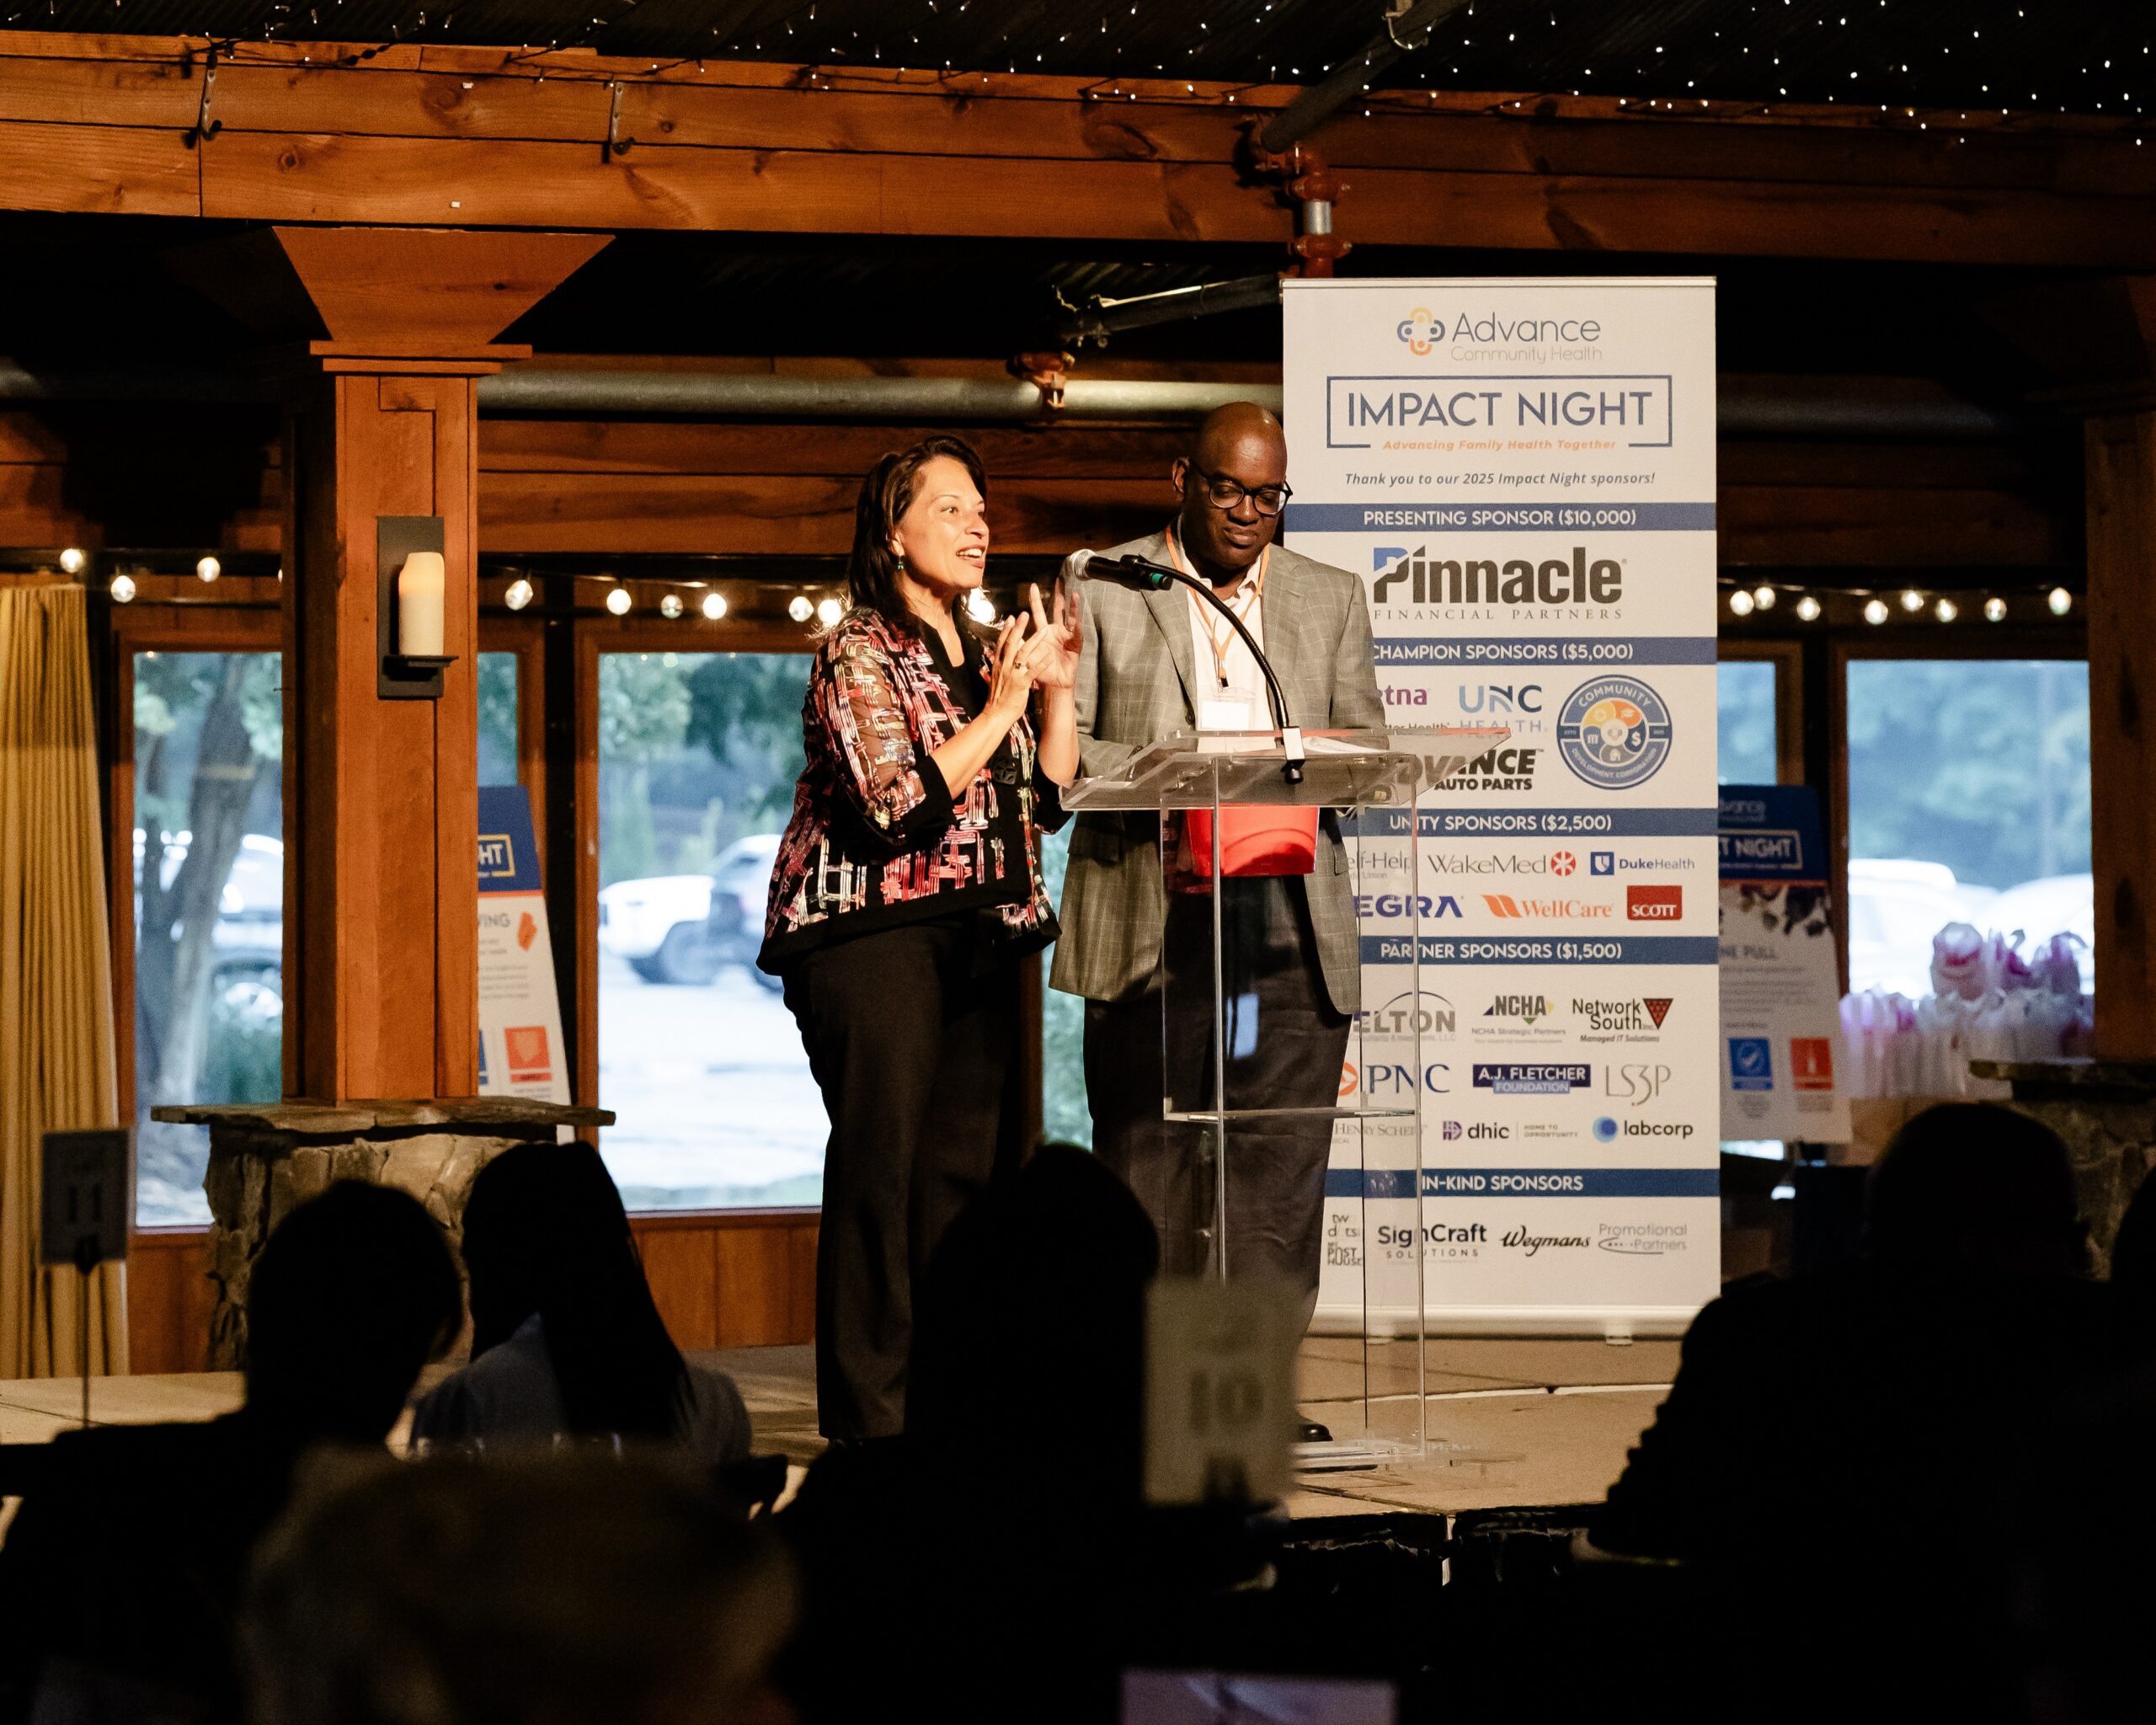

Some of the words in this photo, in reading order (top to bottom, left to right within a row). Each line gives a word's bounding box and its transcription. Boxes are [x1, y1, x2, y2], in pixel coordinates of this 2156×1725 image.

[1451, 312, 1601, 344] Advance
[1450, 345, 1546, 365] Community
[1551, 345, 1603, 361] Health
[1348, 392, 1502, 426] IMPACT
[1518, 391, 1652, 426] NIGHT
[1382, 440, 1454, 452] Advancing
[1459, 440, 1503, 451] Family
[1508, 440, 1553, 451] Health
[1557, 440, 1616, 451] Together
[1345, 473, 1386, 485] Thank
[1390, 476, 1414, 488] you
[1418, 474, 1433, 485] to
[1436, 476, 1459, 485] our
[1463, 473, 1494, 485] 2025
[1497, 473, 1545, 487] Impact
[1550, 473, 1587, 487] Night
[1591, 473, 1655, 487] sponsors!
[1364, 510, 1467, 526] PRESENTING
[1471, 510, 1554, 526] SPONSOR
[1558, 510, 1636, 526] ($10,000)
[1374, 545, 1622, 605] Pinnacle
[1374, 609, 1494, 621] FINANCIAL
[1513, 608, 1622, 621] PARTNERS
[1465, 644, 1557, 660] SPONSORS
[1562, 644, 1634, 660] ($5,000)
[1384, 685, 1428, 705] tna
[1459, 684, 1542, 713] UNC
[1578, 684, 1651, 708] COMMUNITY
[1460, 719, 1541, 733] HEALTH
[1396, 749, 1536, 784] DVANCE
[1434, 778, 1479, 790] AUTO
[1482, 778, 1532, 790] PARTS
[1390, 815, 1439, 830] UNITY
[1445, 815, 1537, 830] SPONSORS
[1541, 815, 1612, 831] ($2,500)
[1735, 839, 1792, 858] NIGHT
[1348, 851, 1411, 874] elf-Help
[1428, 853, 1546, 874] WakeMed
[1619, 857, 1695, 870] DukeHealth
[1353, 895, 1463, 918] EGRA
[1522, 900, 1612, 918] WellCare
[1631, 904, 1677, 917] SCOTT
[1460, 943, 1552, 959] SPONSORS
[1556, 943, 1622, 959] ($1,500)
[1495, 996, 1547, 1016] NCHA
[1572, 998, 1641, 1015] Network
[1590, 1012, 1641, 1030] South
[1579, 1034, 1614, 1044] Managed
[1616, 1034, 1624, 1043] IT
[1625, 1034, 1659, 1043] Solutions
[1365, 1064, 1450, 1094] PNC
[1478, 1067, 1505, 1081] A.J.
[1510, 1067, 1586, 1081] FLETCHER
[1494, 1082, 1569, 1093] FOUNDATION
[1605, 1064, 1672, 1105] LS3P
[1468, 1123, 1510, 1140] dhic
[1624, 1120, 1694, 1140] labcorp
[1422, 1176, 1486, 1191] IN-KIND
[1491, 1176, 1584, 1191] SPONSORS
[1378, 1224, 1487, 1248] SignCraft
[1599, 1224, 1687, 1236] Promotional
[1500, 1225, 1591, 1257] Wegmans
[1635, 1239, 1687, 1251] Partners
